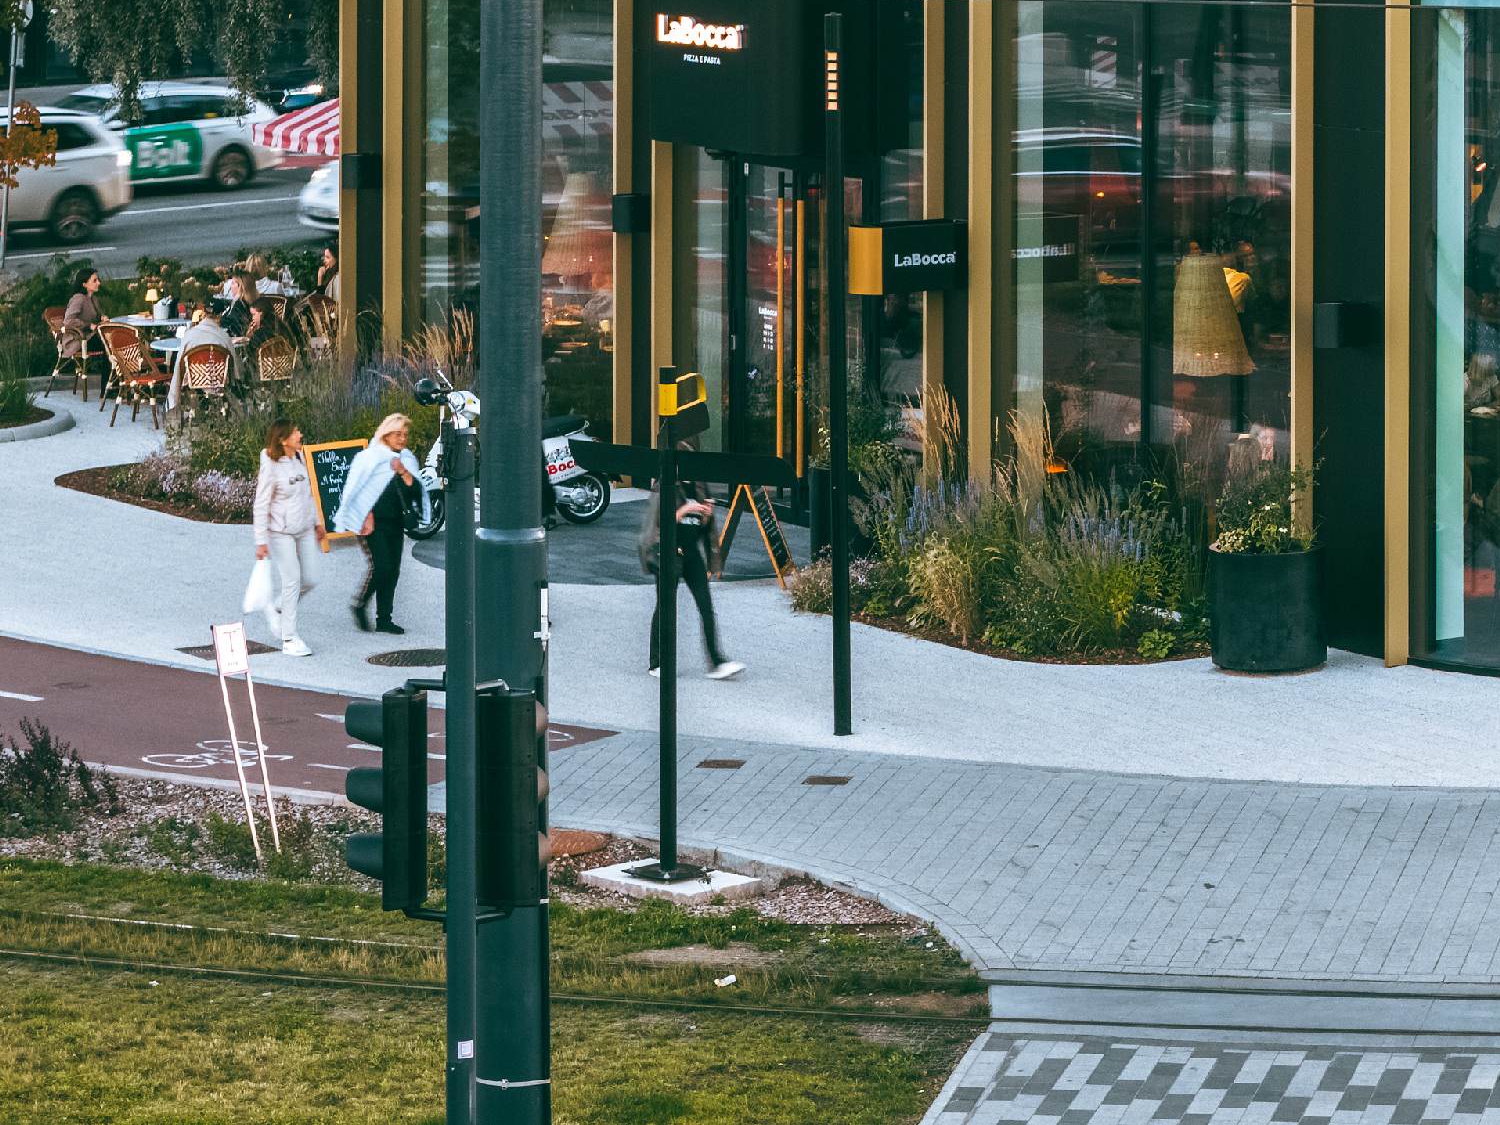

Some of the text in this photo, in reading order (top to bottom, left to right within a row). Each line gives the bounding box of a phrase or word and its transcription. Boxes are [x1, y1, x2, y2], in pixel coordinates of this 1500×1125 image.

[657, 14, 742, 48] LaBocca
[683, 53, 699, 63] PIZZA
[704, 56, 721, 66] PASTA
[894, 252, 956, 268] LaBocca
